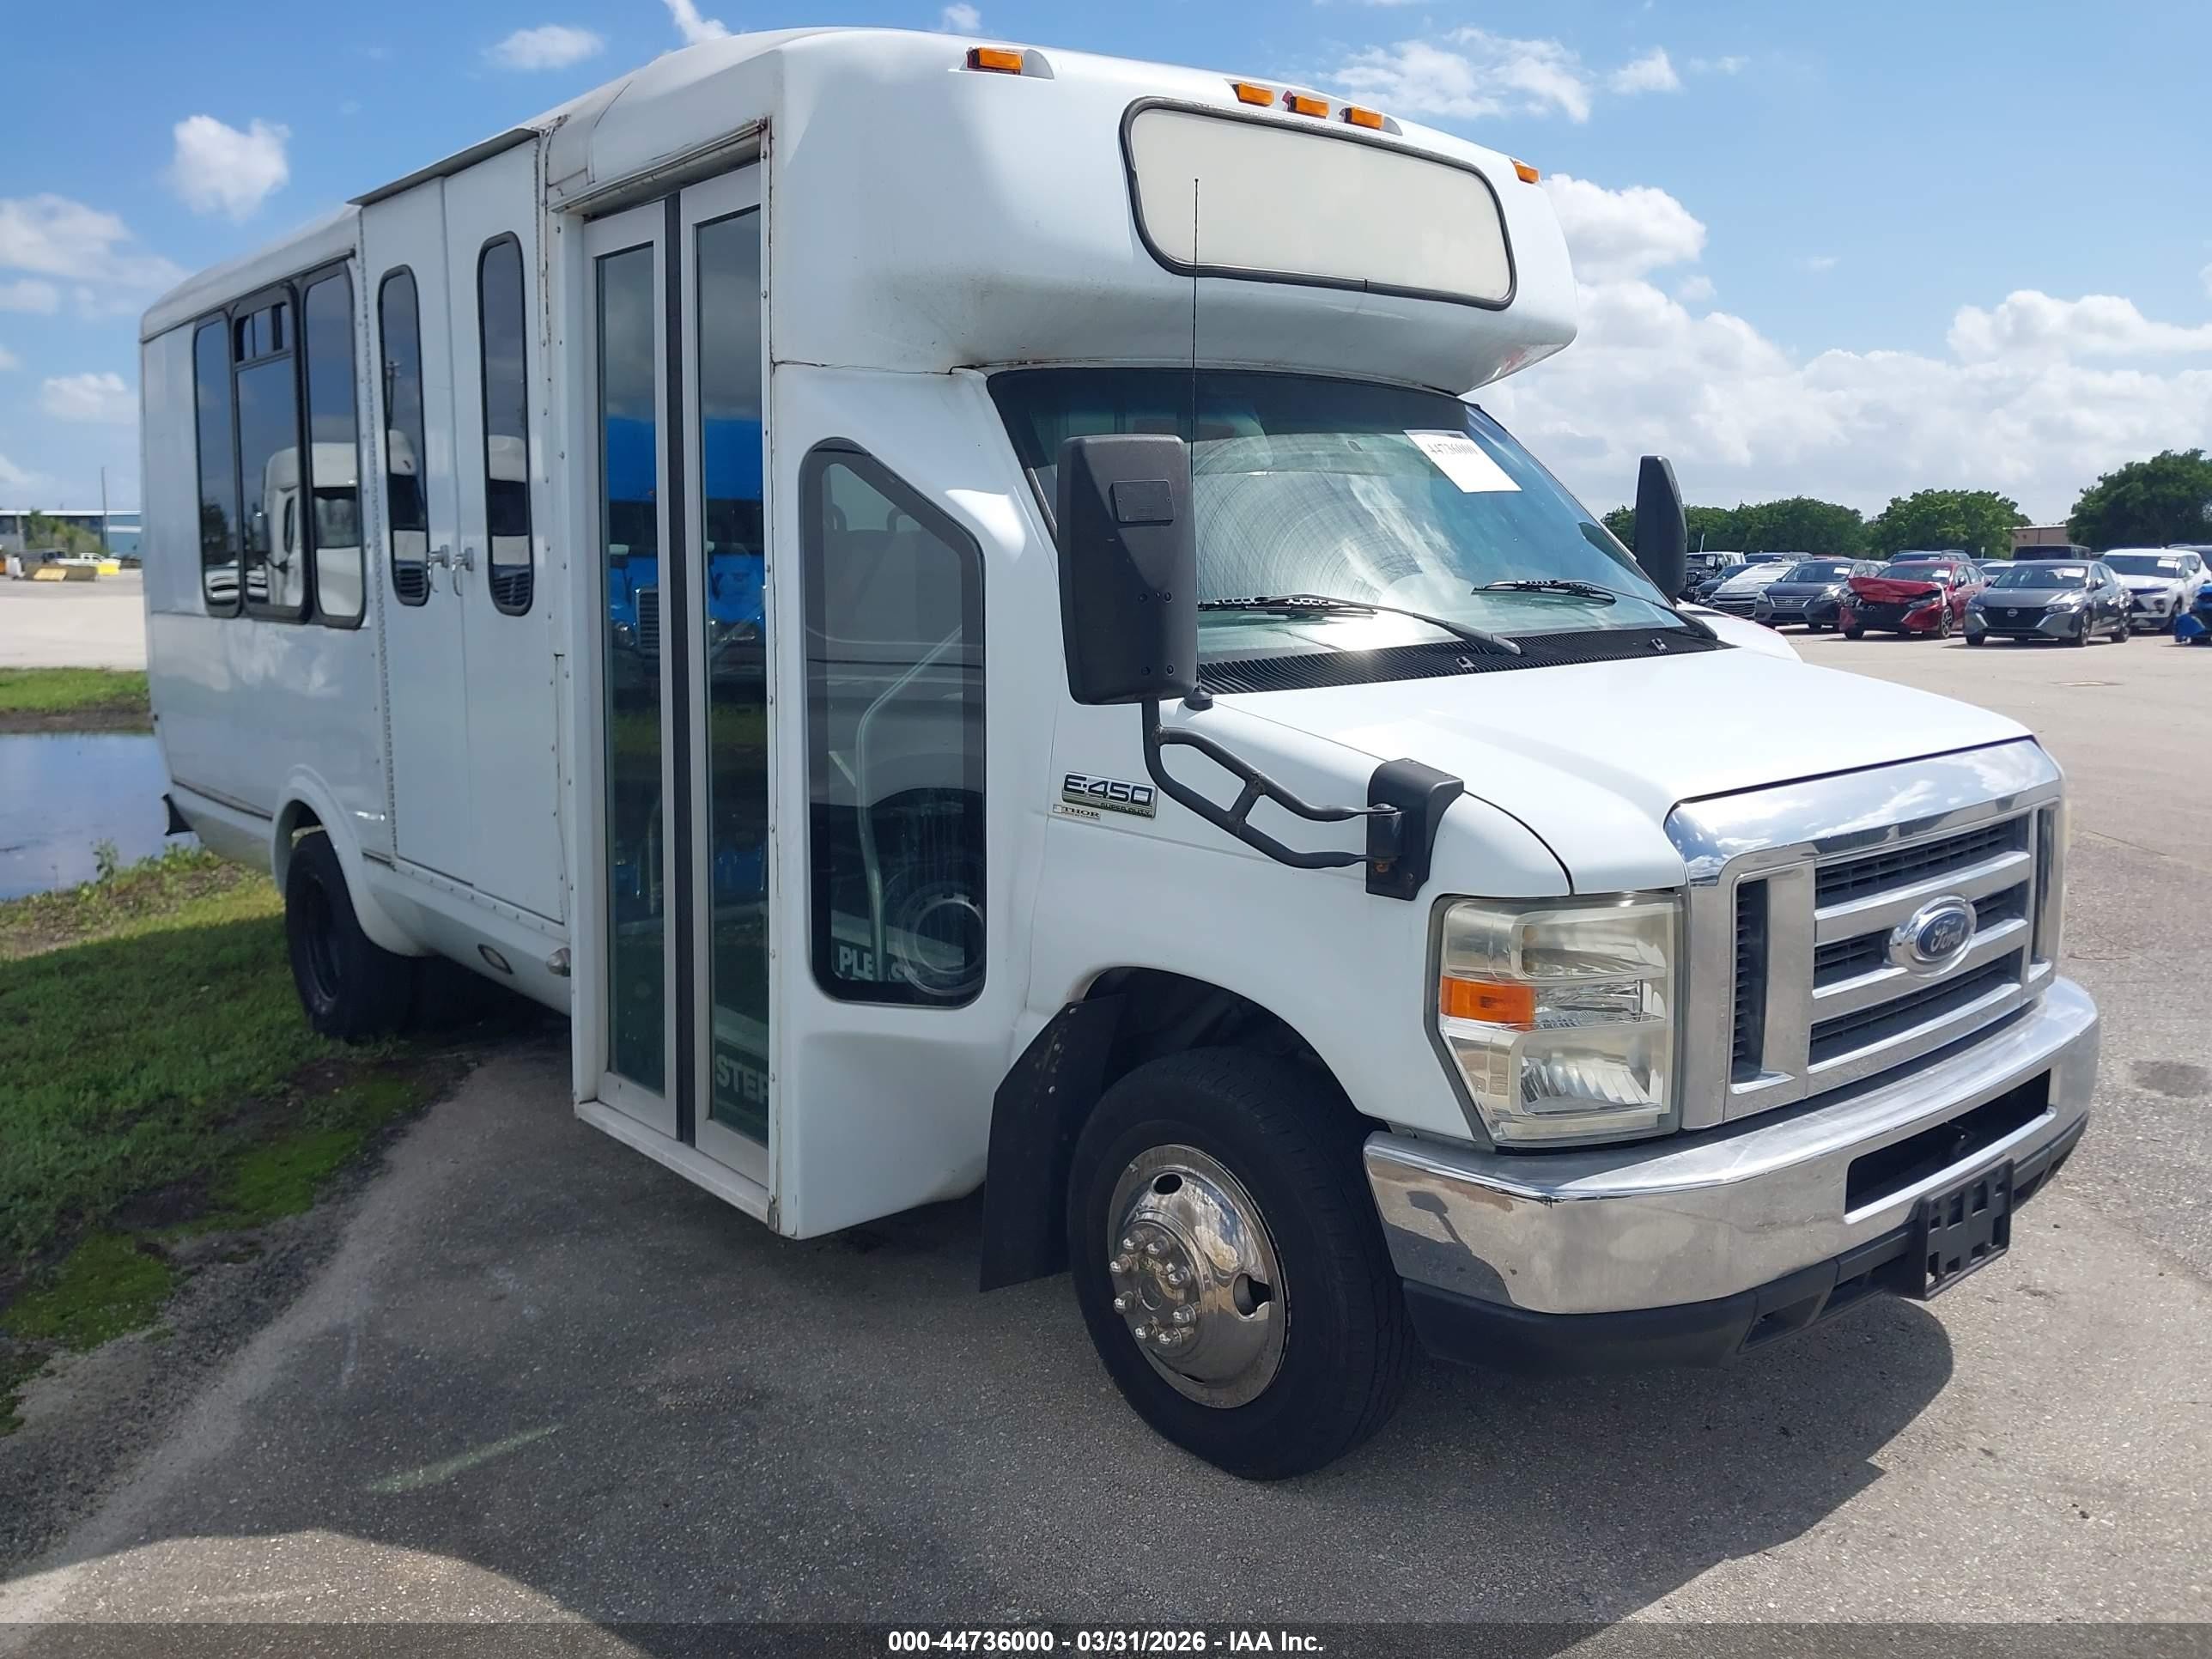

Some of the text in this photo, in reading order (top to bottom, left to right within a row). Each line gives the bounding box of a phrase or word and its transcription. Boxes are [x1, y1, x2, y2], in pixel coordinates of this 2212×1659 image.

[1063, 774, 1153, 806] E-450
[1064, 806, 1100, 817] THOR
[1100, 802, 1151, 817] SUPER DUTY
[1929, 916, 1965, 952] Ford
